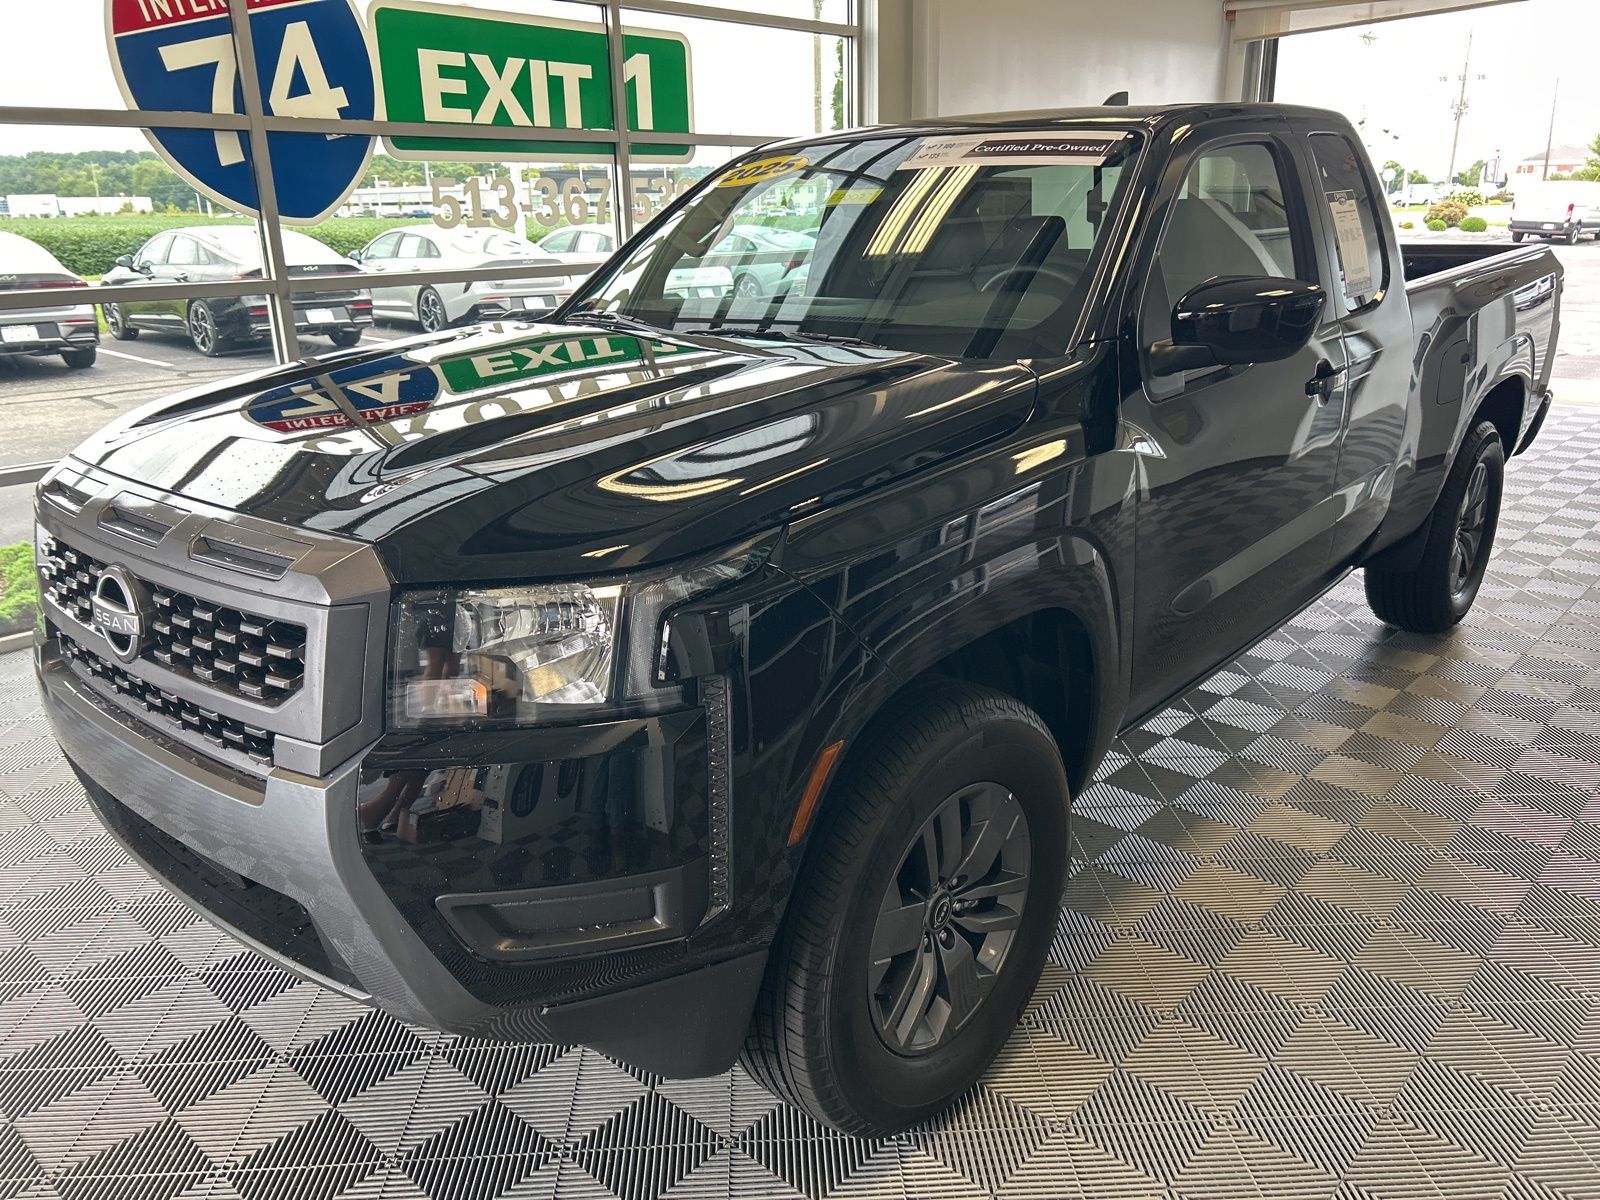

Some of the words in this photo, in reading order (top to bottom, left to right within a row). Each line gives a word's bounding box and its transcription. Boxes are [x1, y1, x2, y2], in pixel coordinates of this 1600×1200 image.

[158, 21, 349, 166] 74
[417, 48, 592, 129] EXIT
[622, 53, 653, 130] 1
[975, 143, 1028, 153] Certified
[1029, 142, 1107, 153] Pre-Owned
[722, 158, 799, 183] 2025
[96, 608, 137, 632] SSAN
